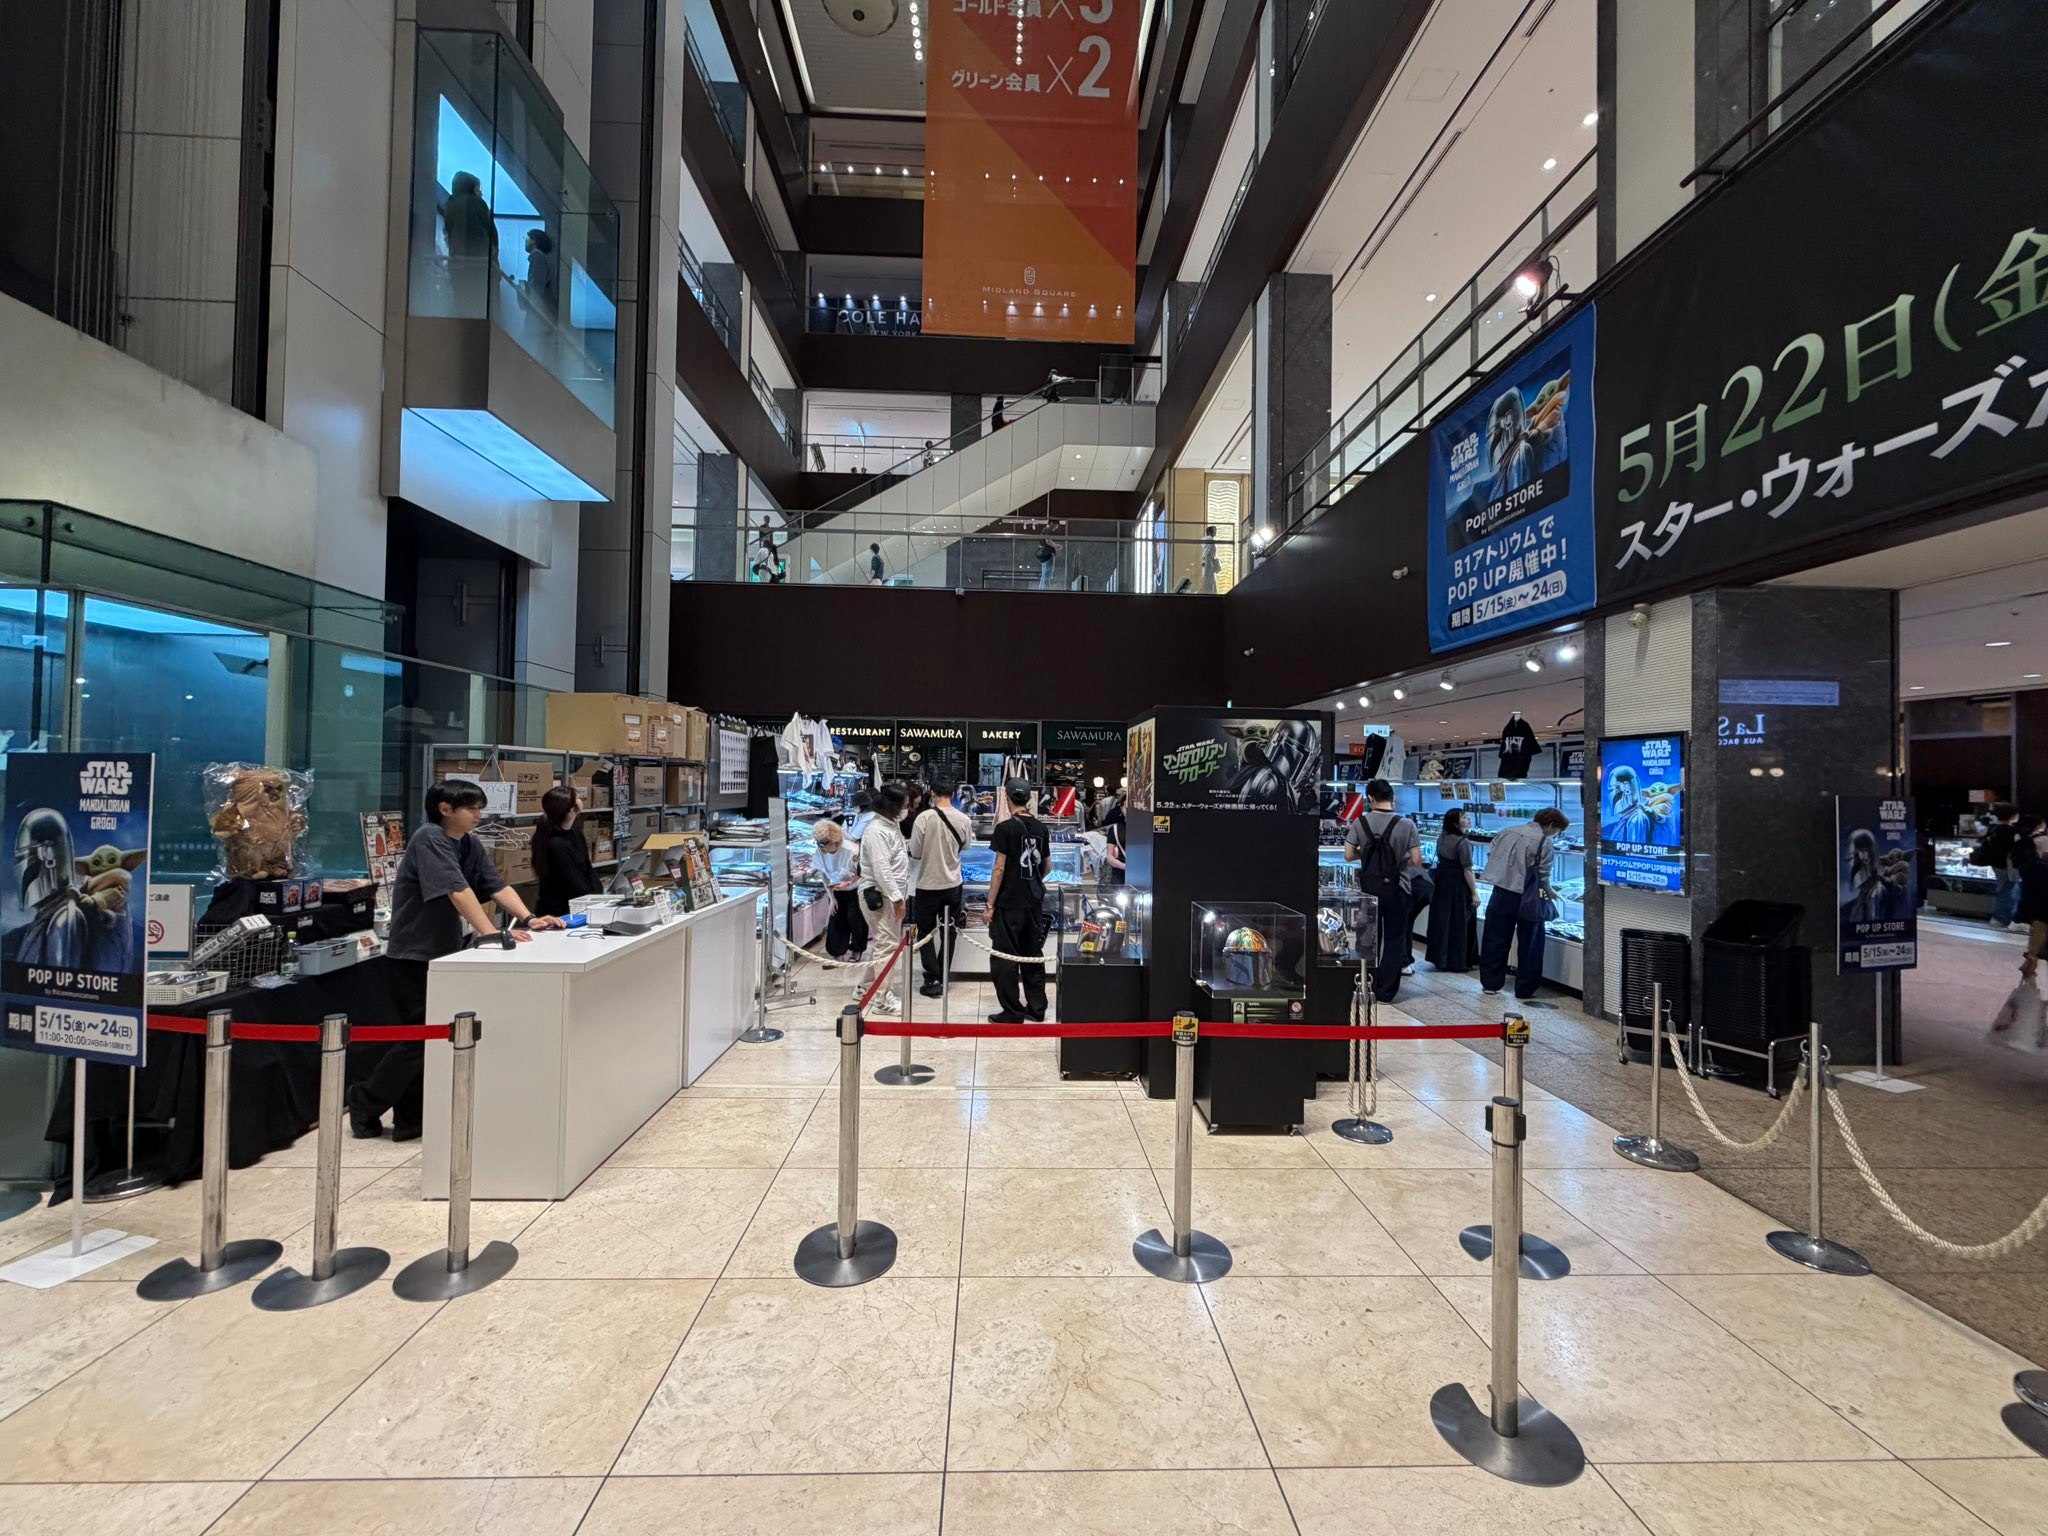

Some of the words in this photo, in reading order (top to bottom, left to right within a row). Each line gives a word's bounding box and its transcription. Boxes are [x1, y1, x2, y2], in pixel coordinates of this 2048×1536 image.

[952, 68, 1041, 93] グリーン会員
[982, 285, 1030, 295] MIDLAND
[1034, 288, 1077, 298] SQUARE
[896, 311, 921, 325] HA
[1466, 513, 1487, 532] POP
[1488, 502, 1502, 521] UP
[1505, 479, 1544, 512] STORE
[1454, 515, 1555, 579] B1アトリウムで
[1448, 579, 1478, 605] POP
[1451, 607, 1471, 628] 期間
[830, 727, 891, 737] RESTAURANT
[899, 728, 963, 739] SAWAMURA
[982, 730, 1021, 740] BAKERY
[1057, 730, 1122, 741] SAWAMURA
[1642, 740, 1671, 750] STAR
[1163, 742, 1228, 770] マンダロリアン
[1642, 748, 1672, 758] WARS
[80, 761, 133, 778] STAR
[80, 777, 132, 795] WARS
[79, 798, 130, 813] MANDALORIAN
[1879, 800, 1906, 811] STAR
[1879, 810, 1906, 820] WARS
[1616, 843, 1632, 852] POP
[1632, 844, 1643, 853] UP
[1644, 845, 1668, 855] STORE
[1856, 924, 1870, 933] POP
[1871, 923, 1882, 932] UP
[1883, 921, 1905, 932] STORE
[28, 968, 52, 984] POP
[56, 971, 73, 987] UP
[77, 974, 118, 992] STORE
